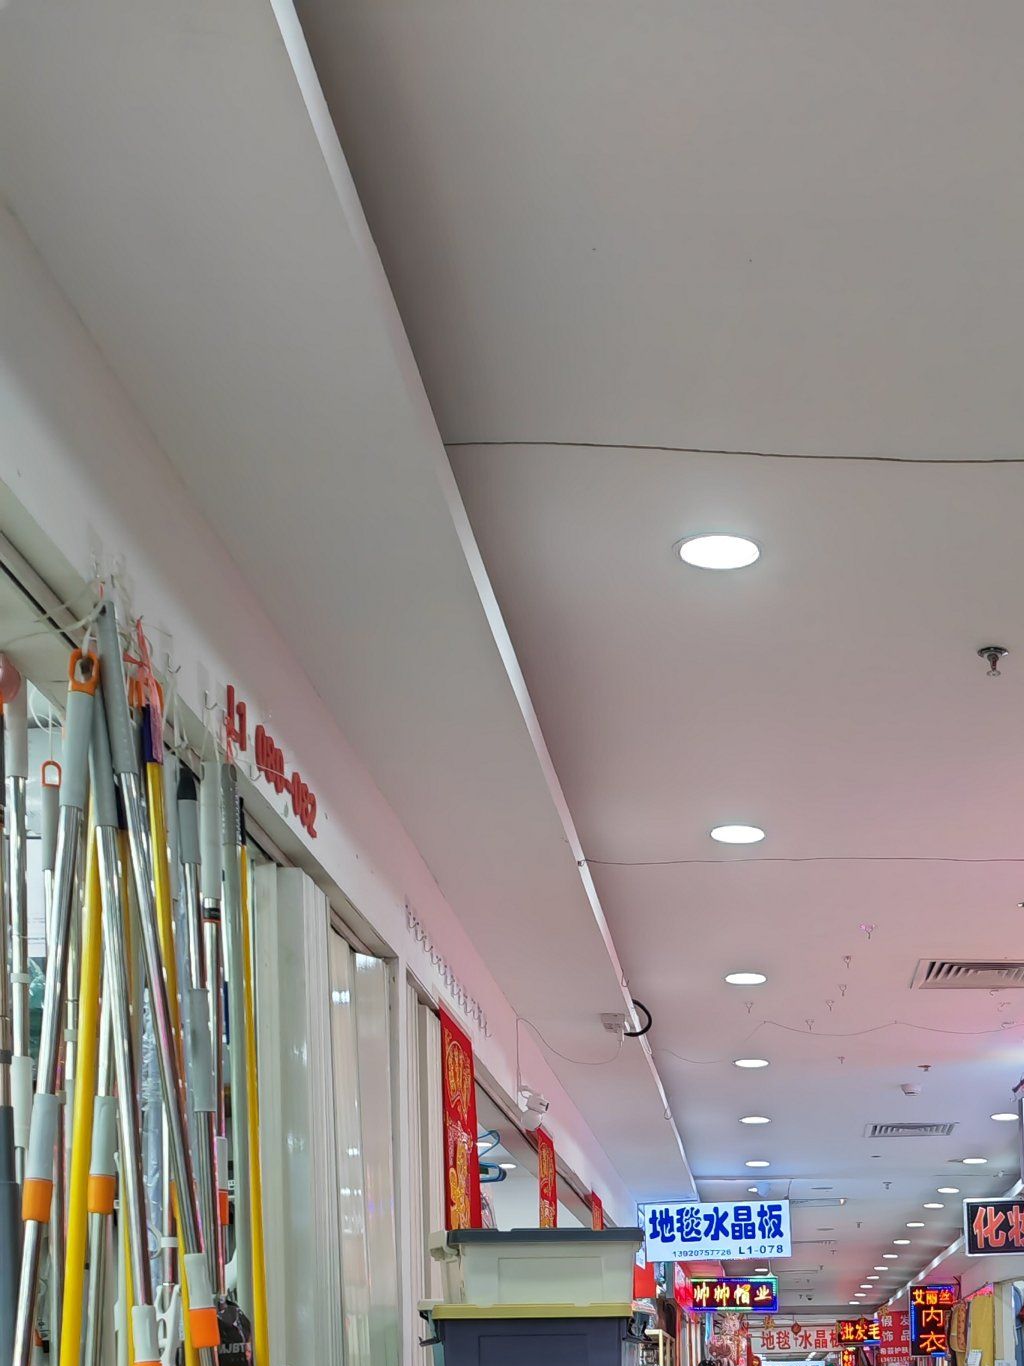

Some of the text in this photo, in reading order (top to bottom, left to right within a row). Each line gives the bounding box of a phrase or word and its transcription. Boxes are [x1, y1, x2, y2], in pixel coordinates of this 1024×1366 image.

[226, 684, 247, 752] L1
[649, 1204, 784, 1243] 地毯水晶板
[738, 1244, 784, 1254] L1-078
[693, 1282, 772, 1307] 帅帅帽业
[912, 1289, 953, 1305] 艾丽丝
[761, 1331, 791, 1350] 地毯
[919, 1306, 947, 1352] 内衣
